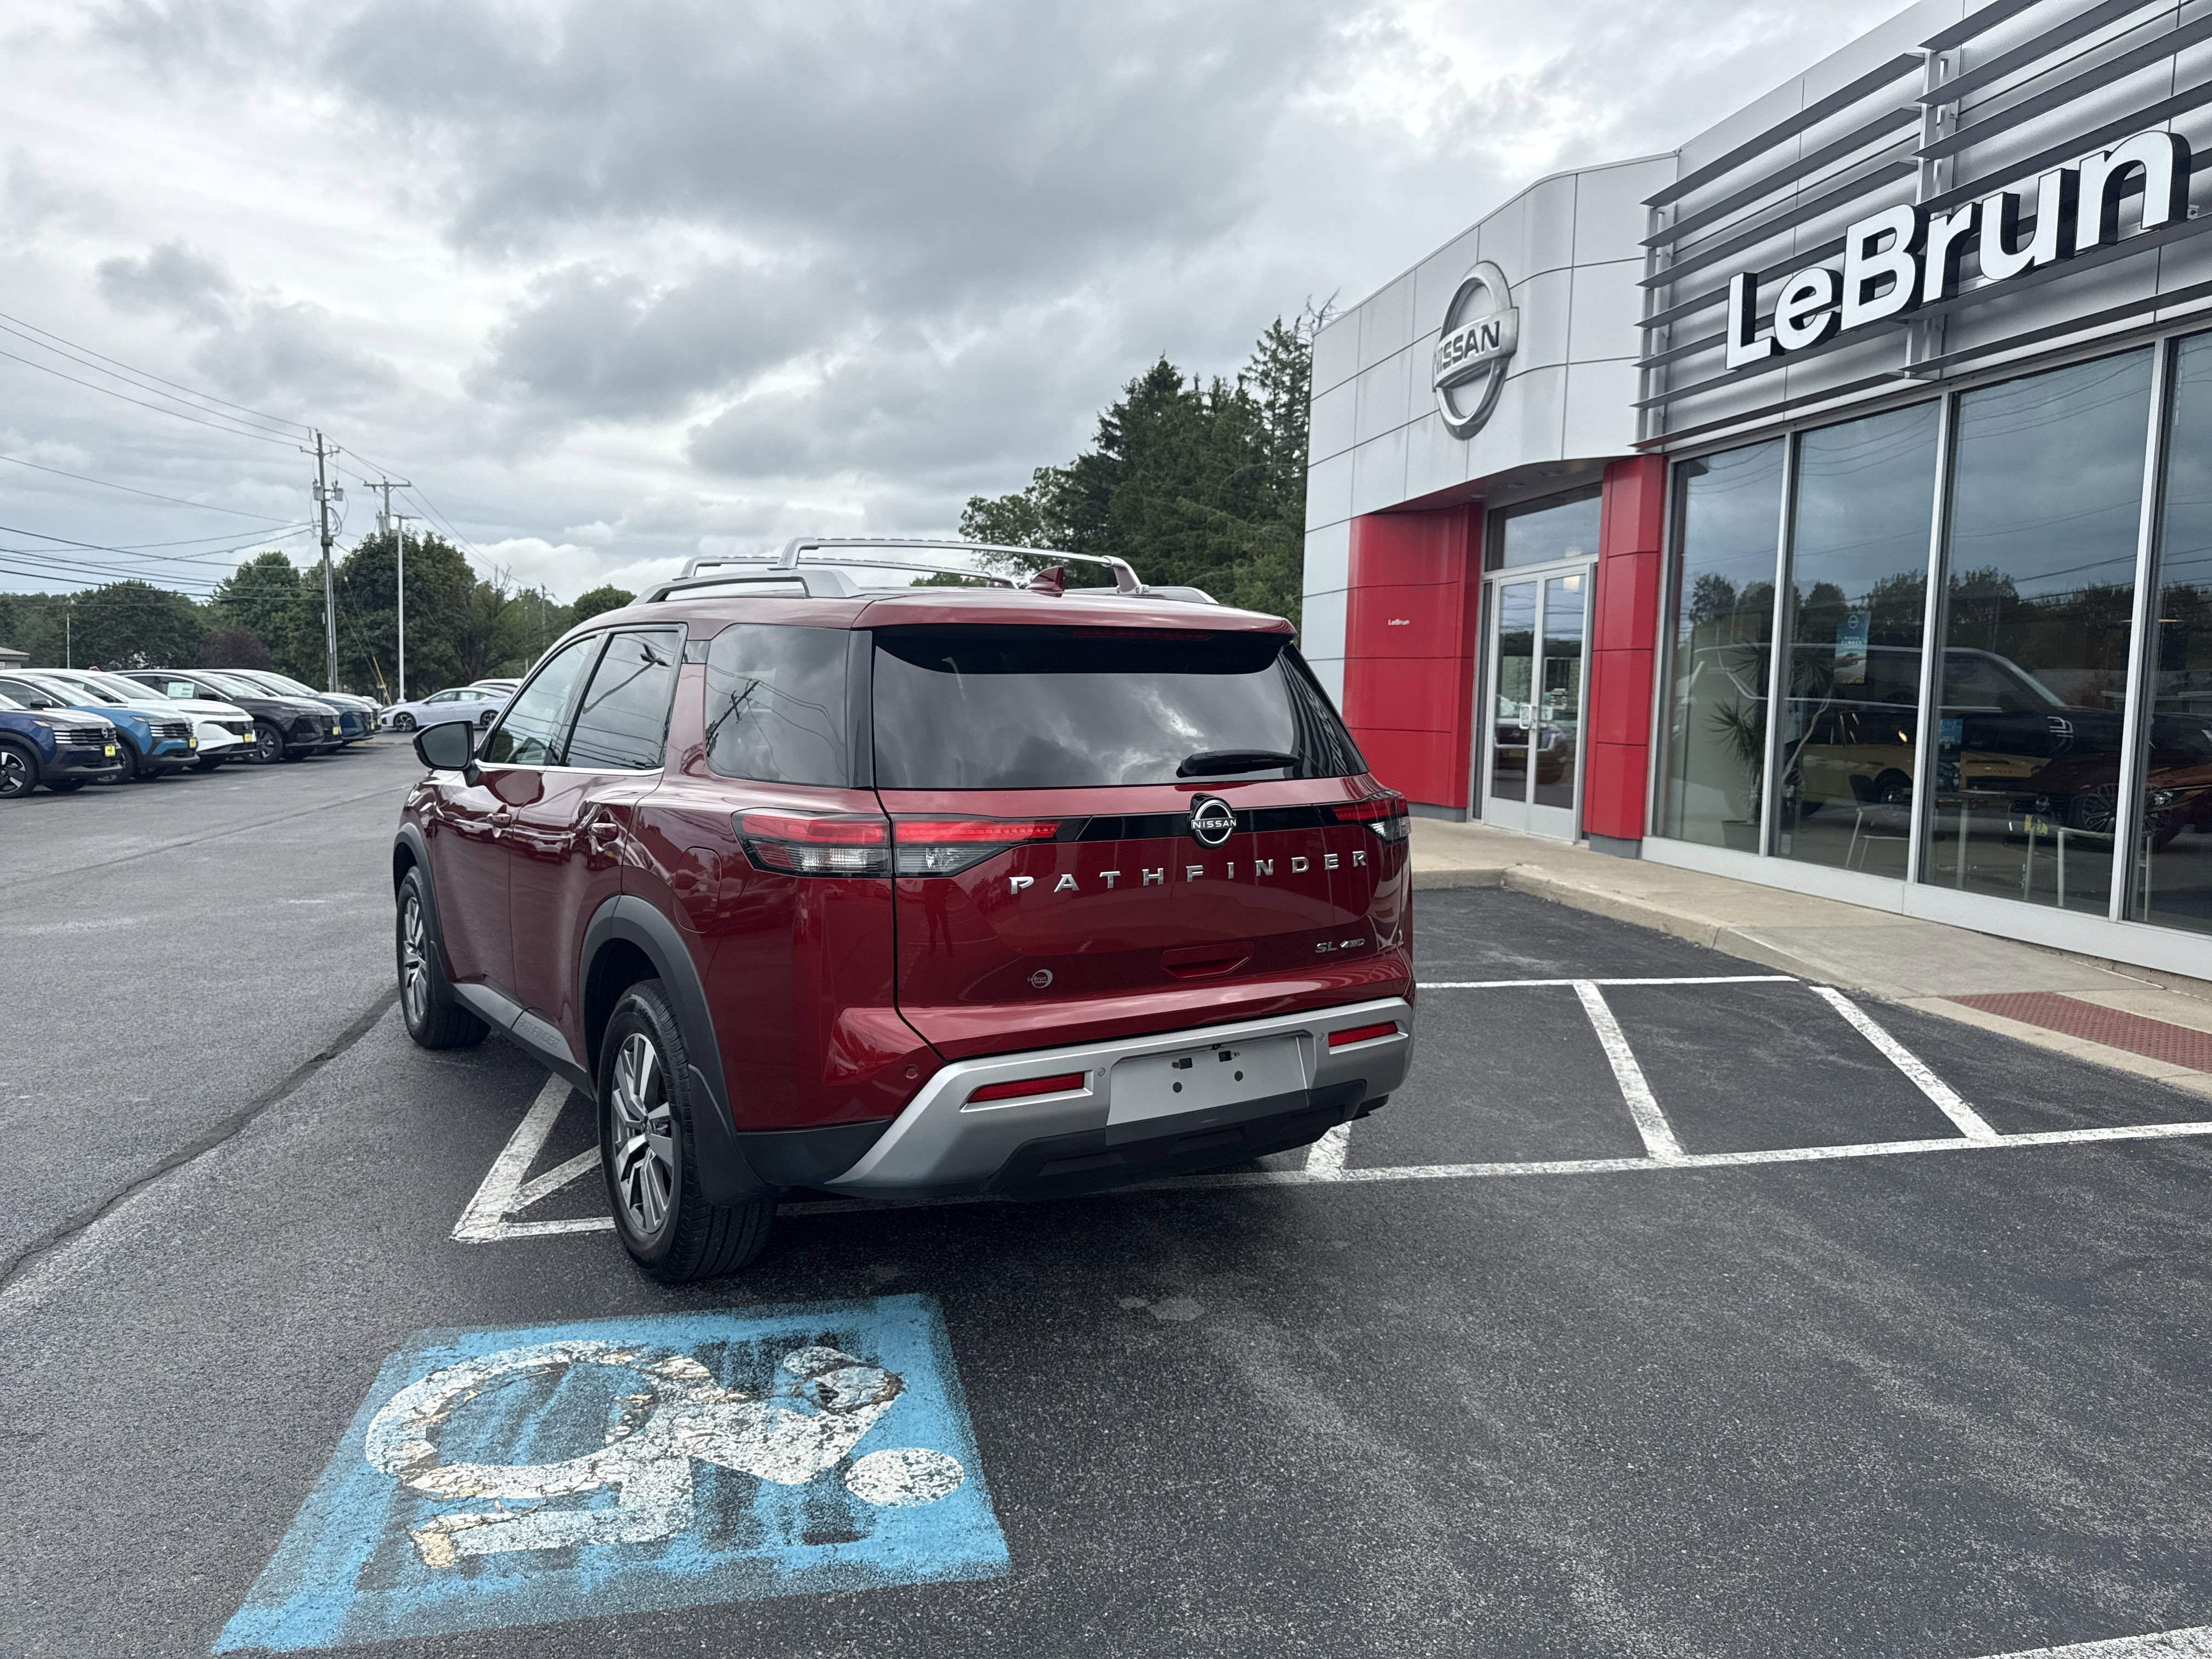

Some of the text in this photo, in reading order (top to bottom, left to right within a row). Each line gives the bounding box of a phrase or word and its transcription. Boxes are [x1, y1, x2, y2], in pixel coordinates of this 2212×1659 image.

[1726, 130, 2186, 370] LeBrun
[1193, 819, 1237, 829] NISSAN
[1009, 850, 1367, 895] PATHFINDER
[1316, 941, 1338, 953] SL
